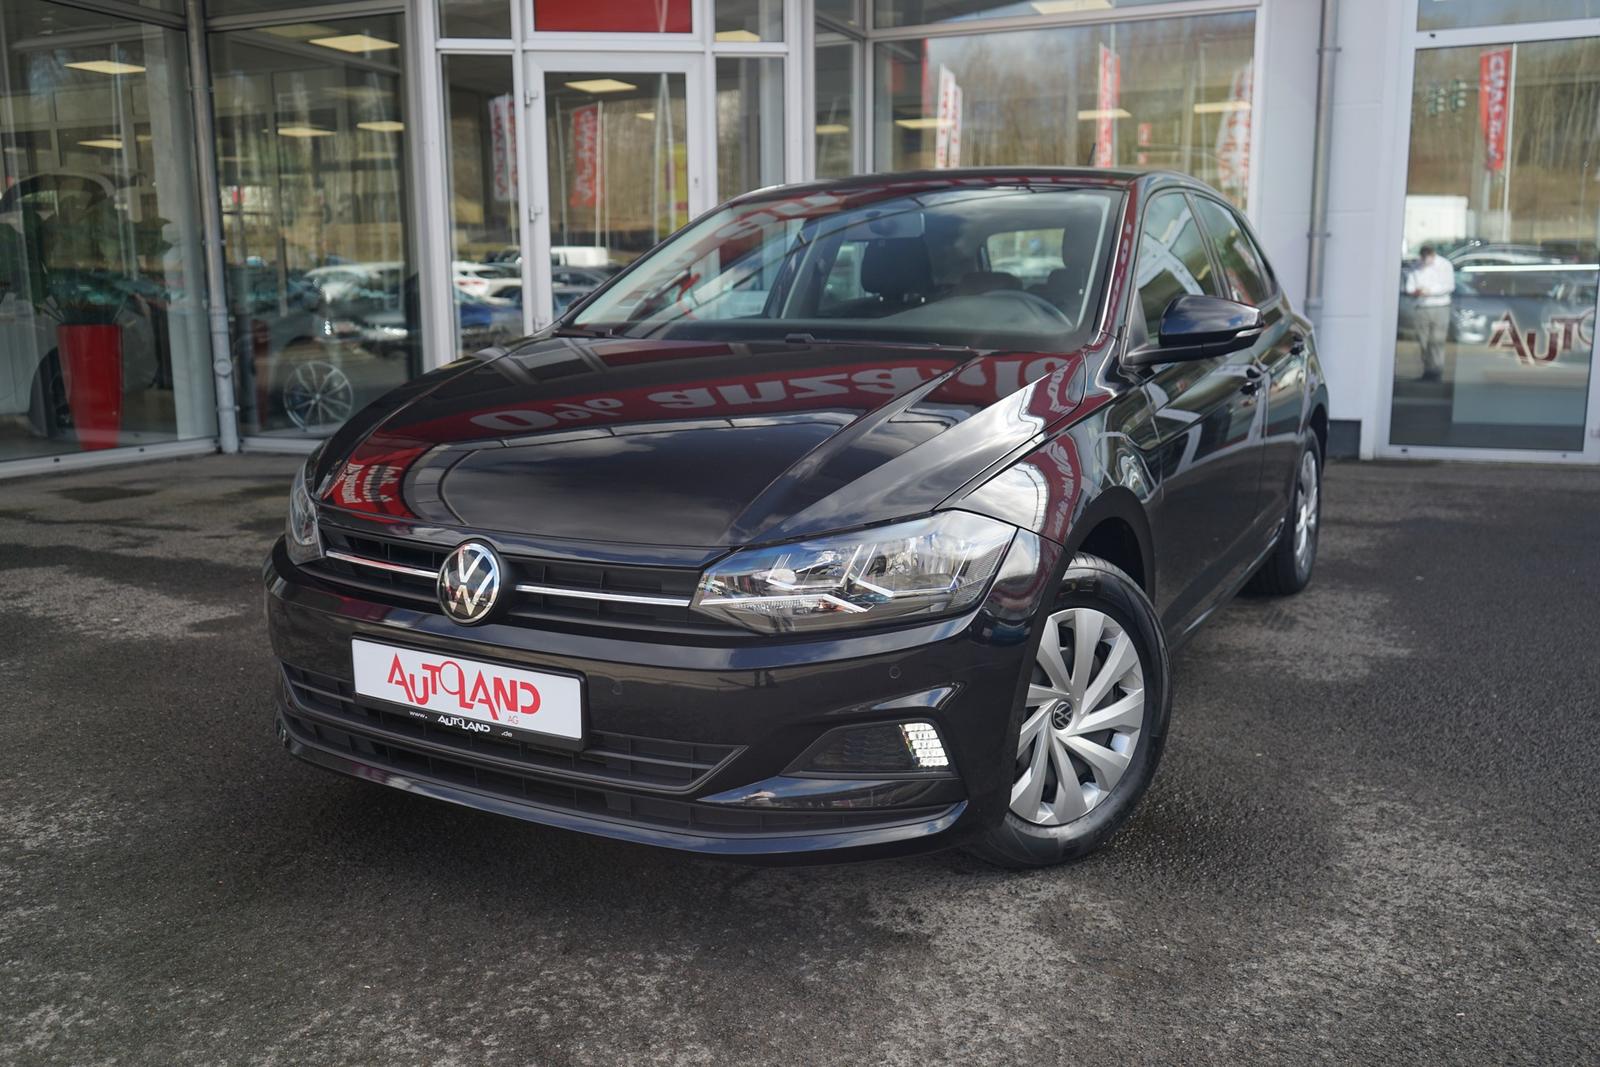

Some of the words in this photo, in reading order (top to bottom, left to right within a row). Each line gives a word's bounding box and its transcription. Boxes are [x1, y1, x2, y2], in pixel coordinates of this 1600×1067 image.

[387, 652, 542, 721] AUTOLAND
[437, 715, 491, 733] AUTOLAND
[507, 715, 519, 725] AG
